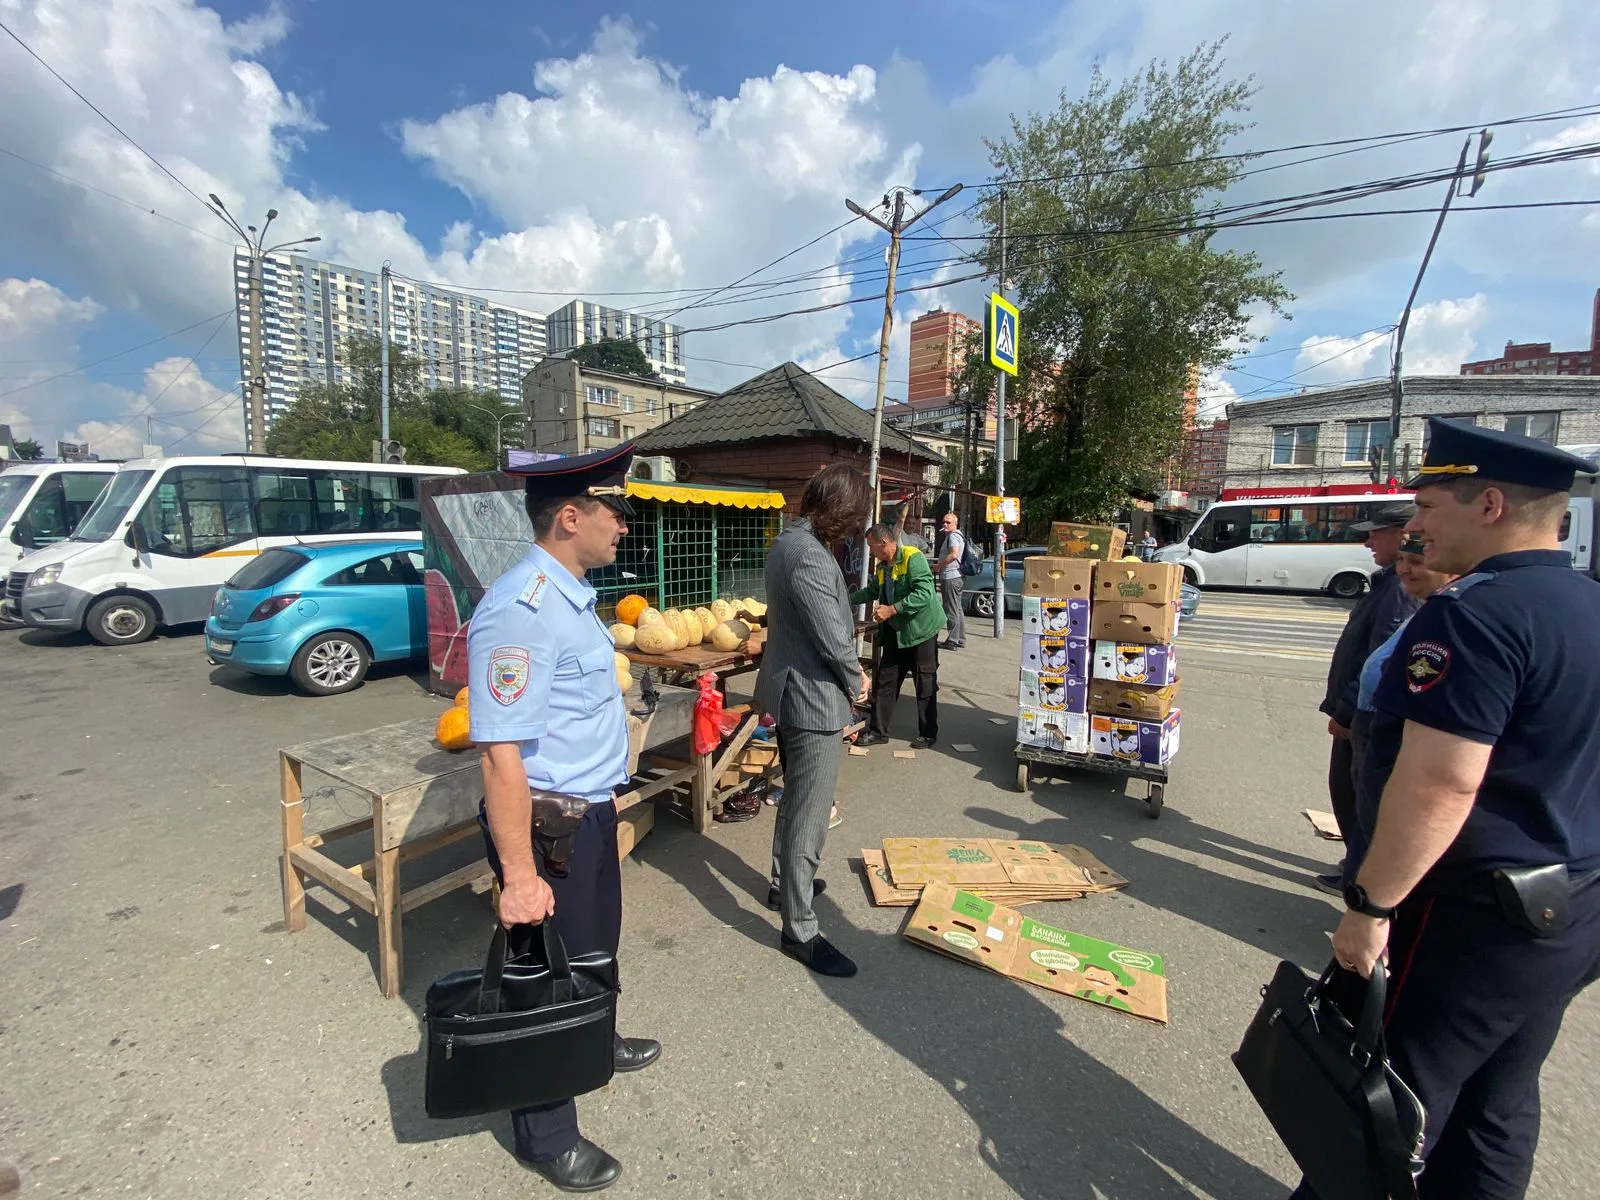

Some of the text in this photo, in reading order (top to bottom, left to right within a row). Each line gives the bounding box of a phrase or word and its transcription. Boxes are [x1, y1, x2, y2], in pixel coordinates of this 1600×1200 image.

[1117, 582, 1141, 590] Global
[955, 855, 992, 864] Global
[1031, 925, 1067, 942] БАНАНЫ
